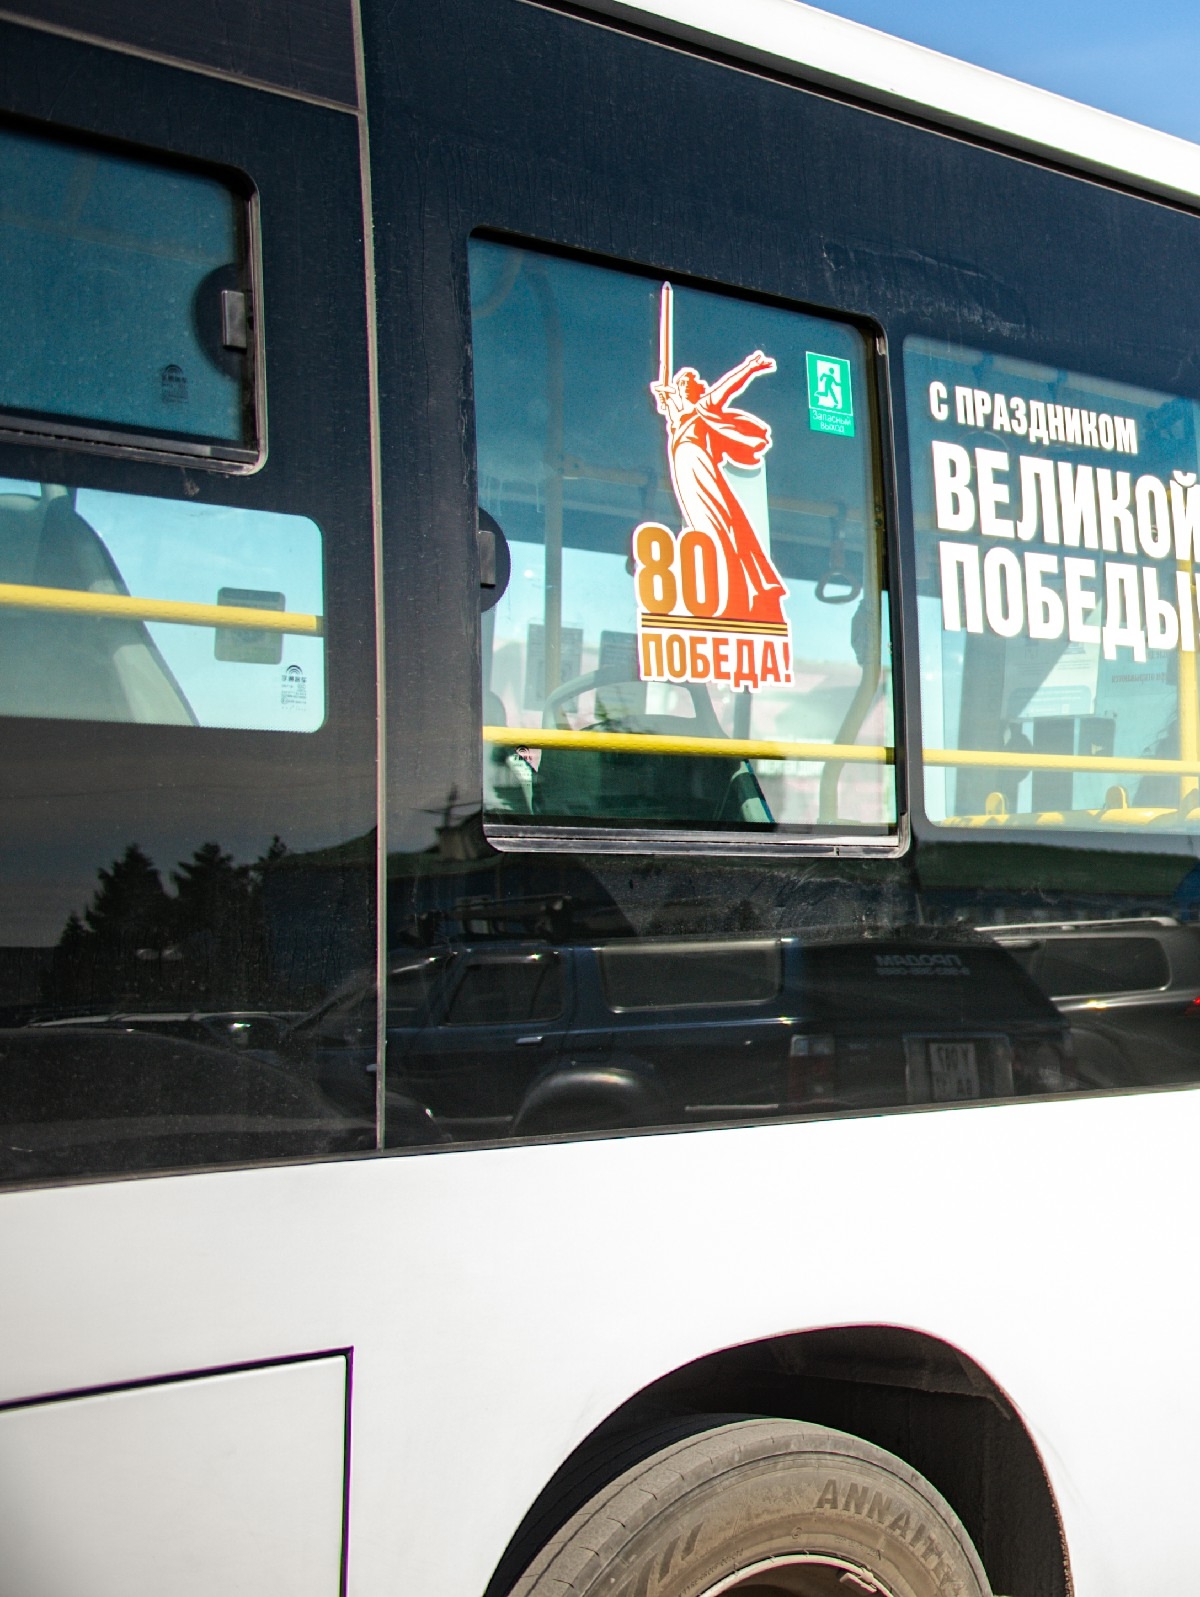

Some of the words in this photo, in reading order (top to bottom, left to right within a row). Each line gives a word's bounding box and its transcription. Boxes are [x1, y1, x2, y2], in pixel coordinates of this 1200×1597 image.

[929, 381, 948, 421] С
[954, 385, 1138, 455] ПРАЗДНИКОМ
[636, 526, 720, 618] 80
[641, 632, 792, 689] ПОБЕДА!
